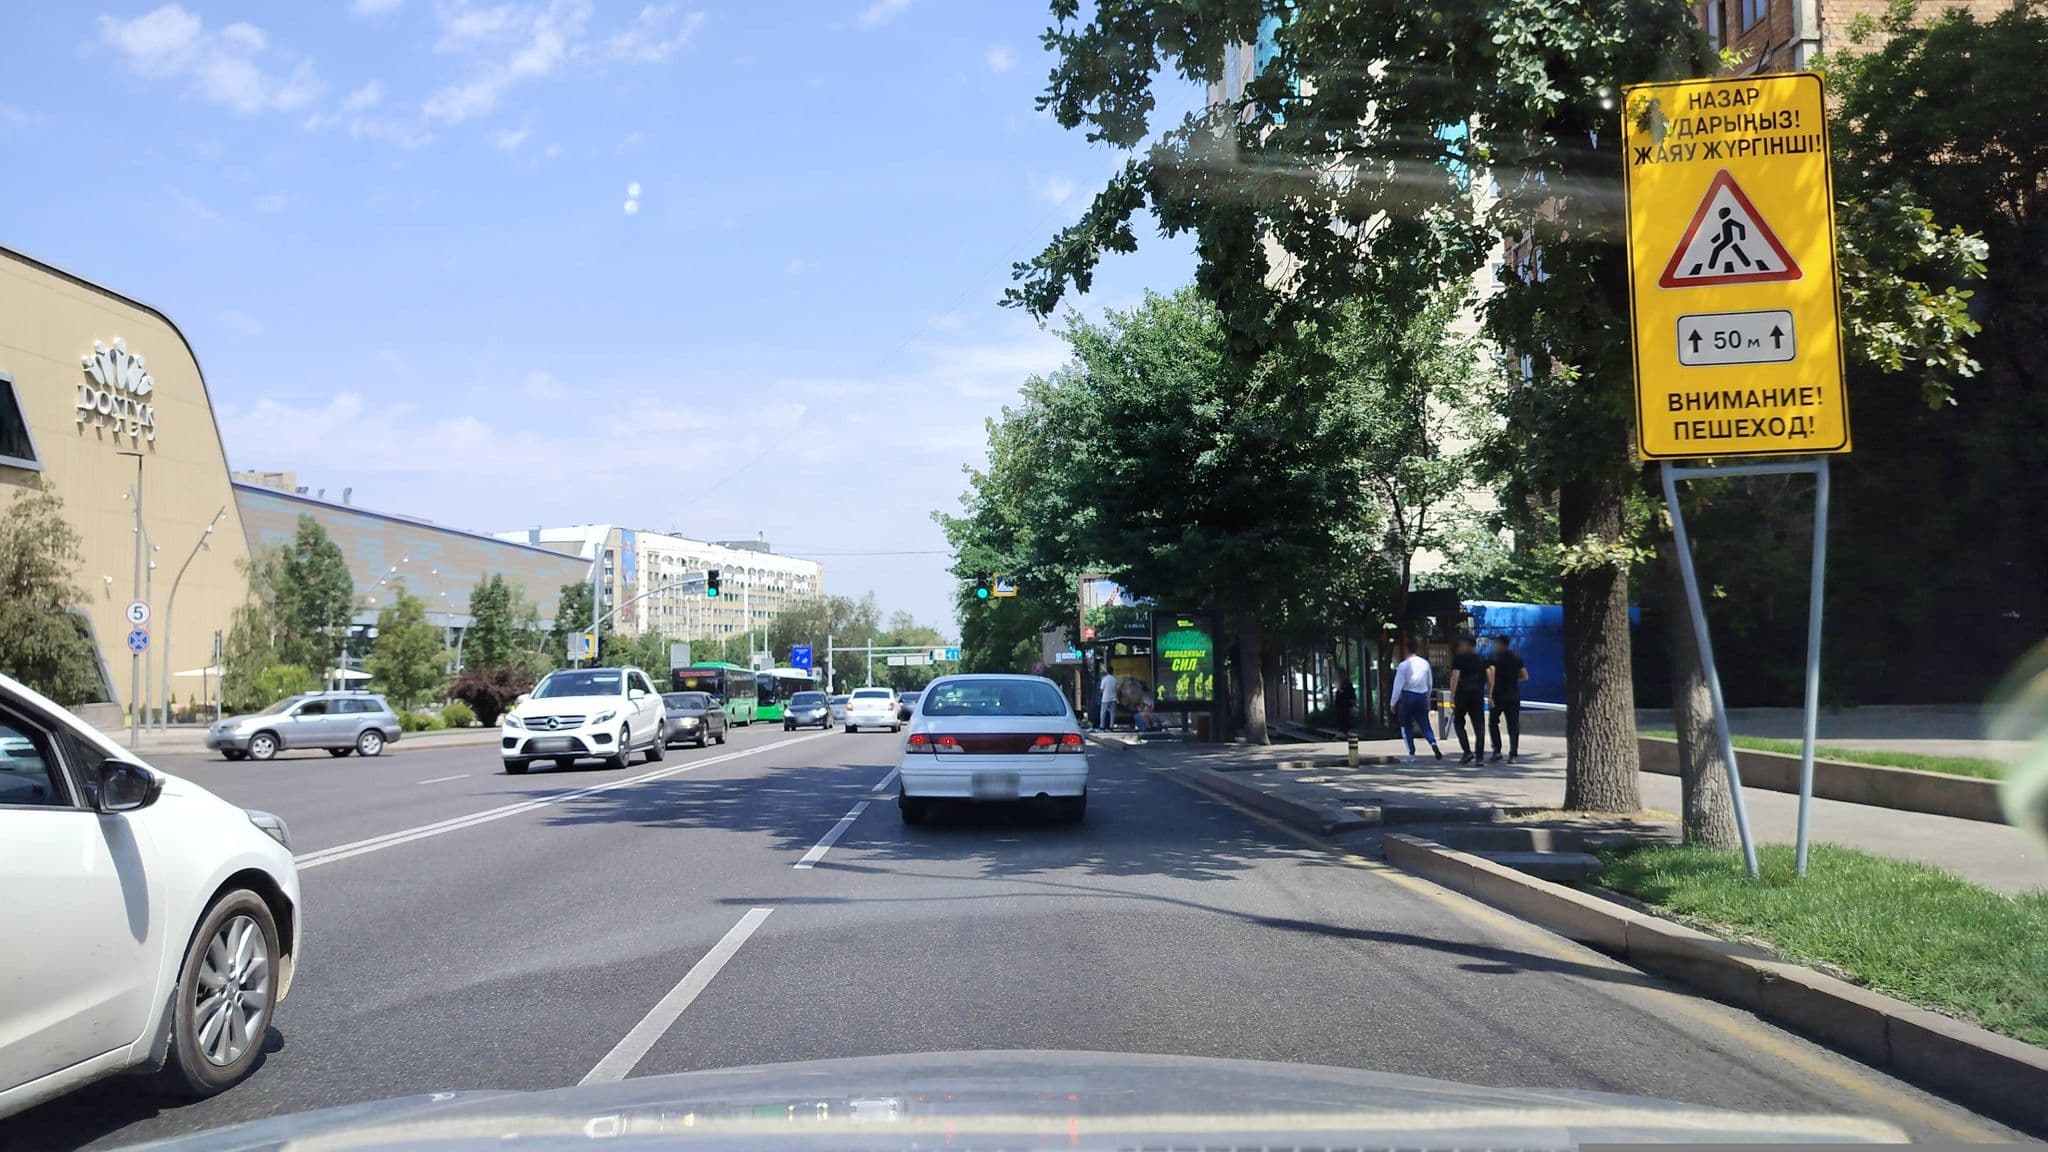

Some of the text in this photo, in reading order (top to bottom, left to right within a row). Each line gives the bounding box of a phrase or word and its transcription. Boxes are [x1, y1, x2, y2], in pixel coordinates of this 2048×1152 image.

[1688, 87, 1760, 111] НАЗАР
[1653, 110, 1801, 140] УДАРЫҢЫЗ!
[1634, 143, 1697, 166] ЖАЯУ
[1713, 330, 1742, 350] 50
[1668, 386, 1823, 412] ВНИМАНИЕ!
[1674, 415, 1816, 441] ПЕШЕХОД!
[133, 605, 144, 621] 5
[1172, 658, 1198, 671] СИЛ
